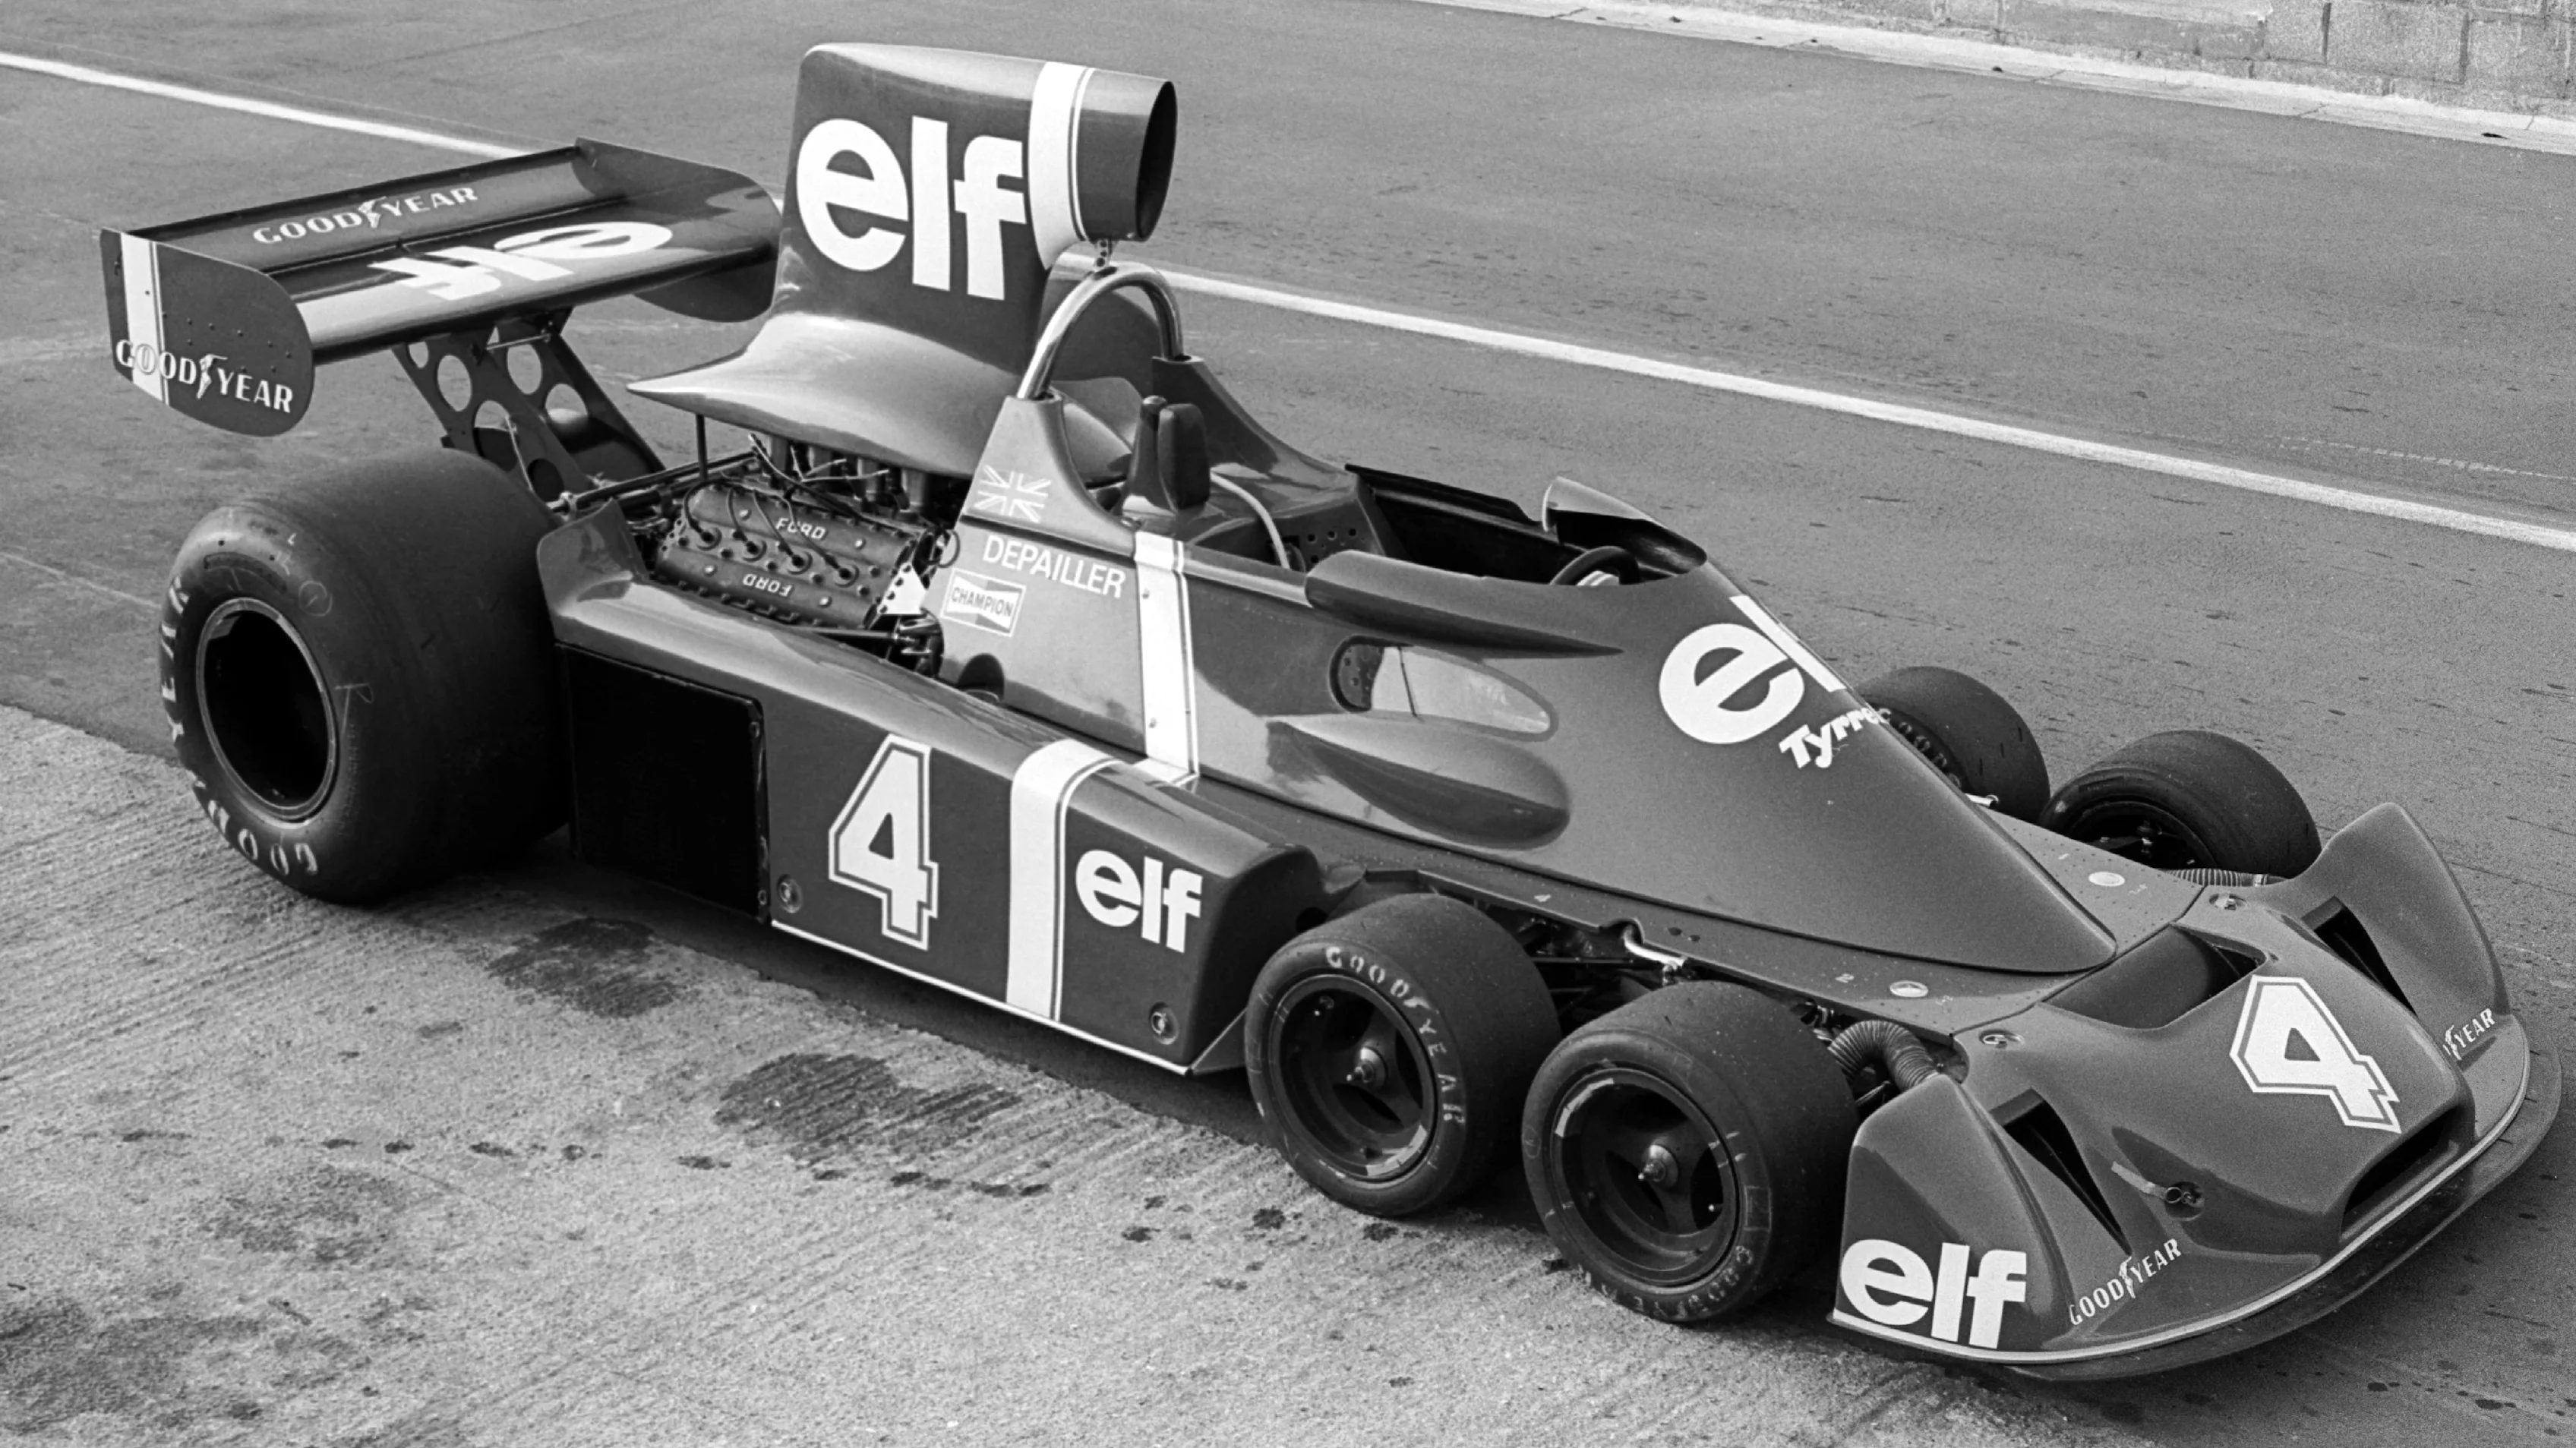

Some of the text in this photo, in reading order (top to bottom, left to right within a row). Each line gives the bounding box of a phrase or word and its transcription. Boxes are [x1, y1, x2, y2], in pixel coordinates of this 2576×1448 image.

[797, 115, 1028, 301] elf
[365, 221, 674, 301] elf
[775, 517, 826, 539] FORD
[982, 534, 1126, 598] DEPAILLER
[742, 573, 794, 597] FORD
[951, 586, 1015, 617] CHAMPION
[1659, 594, 1847, 745] el
[828, 733, 939, 951] 4
[1075, 849, 1204, 953] elf
[2230, 973, 2403, 1134] 4
[1839, 1238, 2027, 1349] elf
